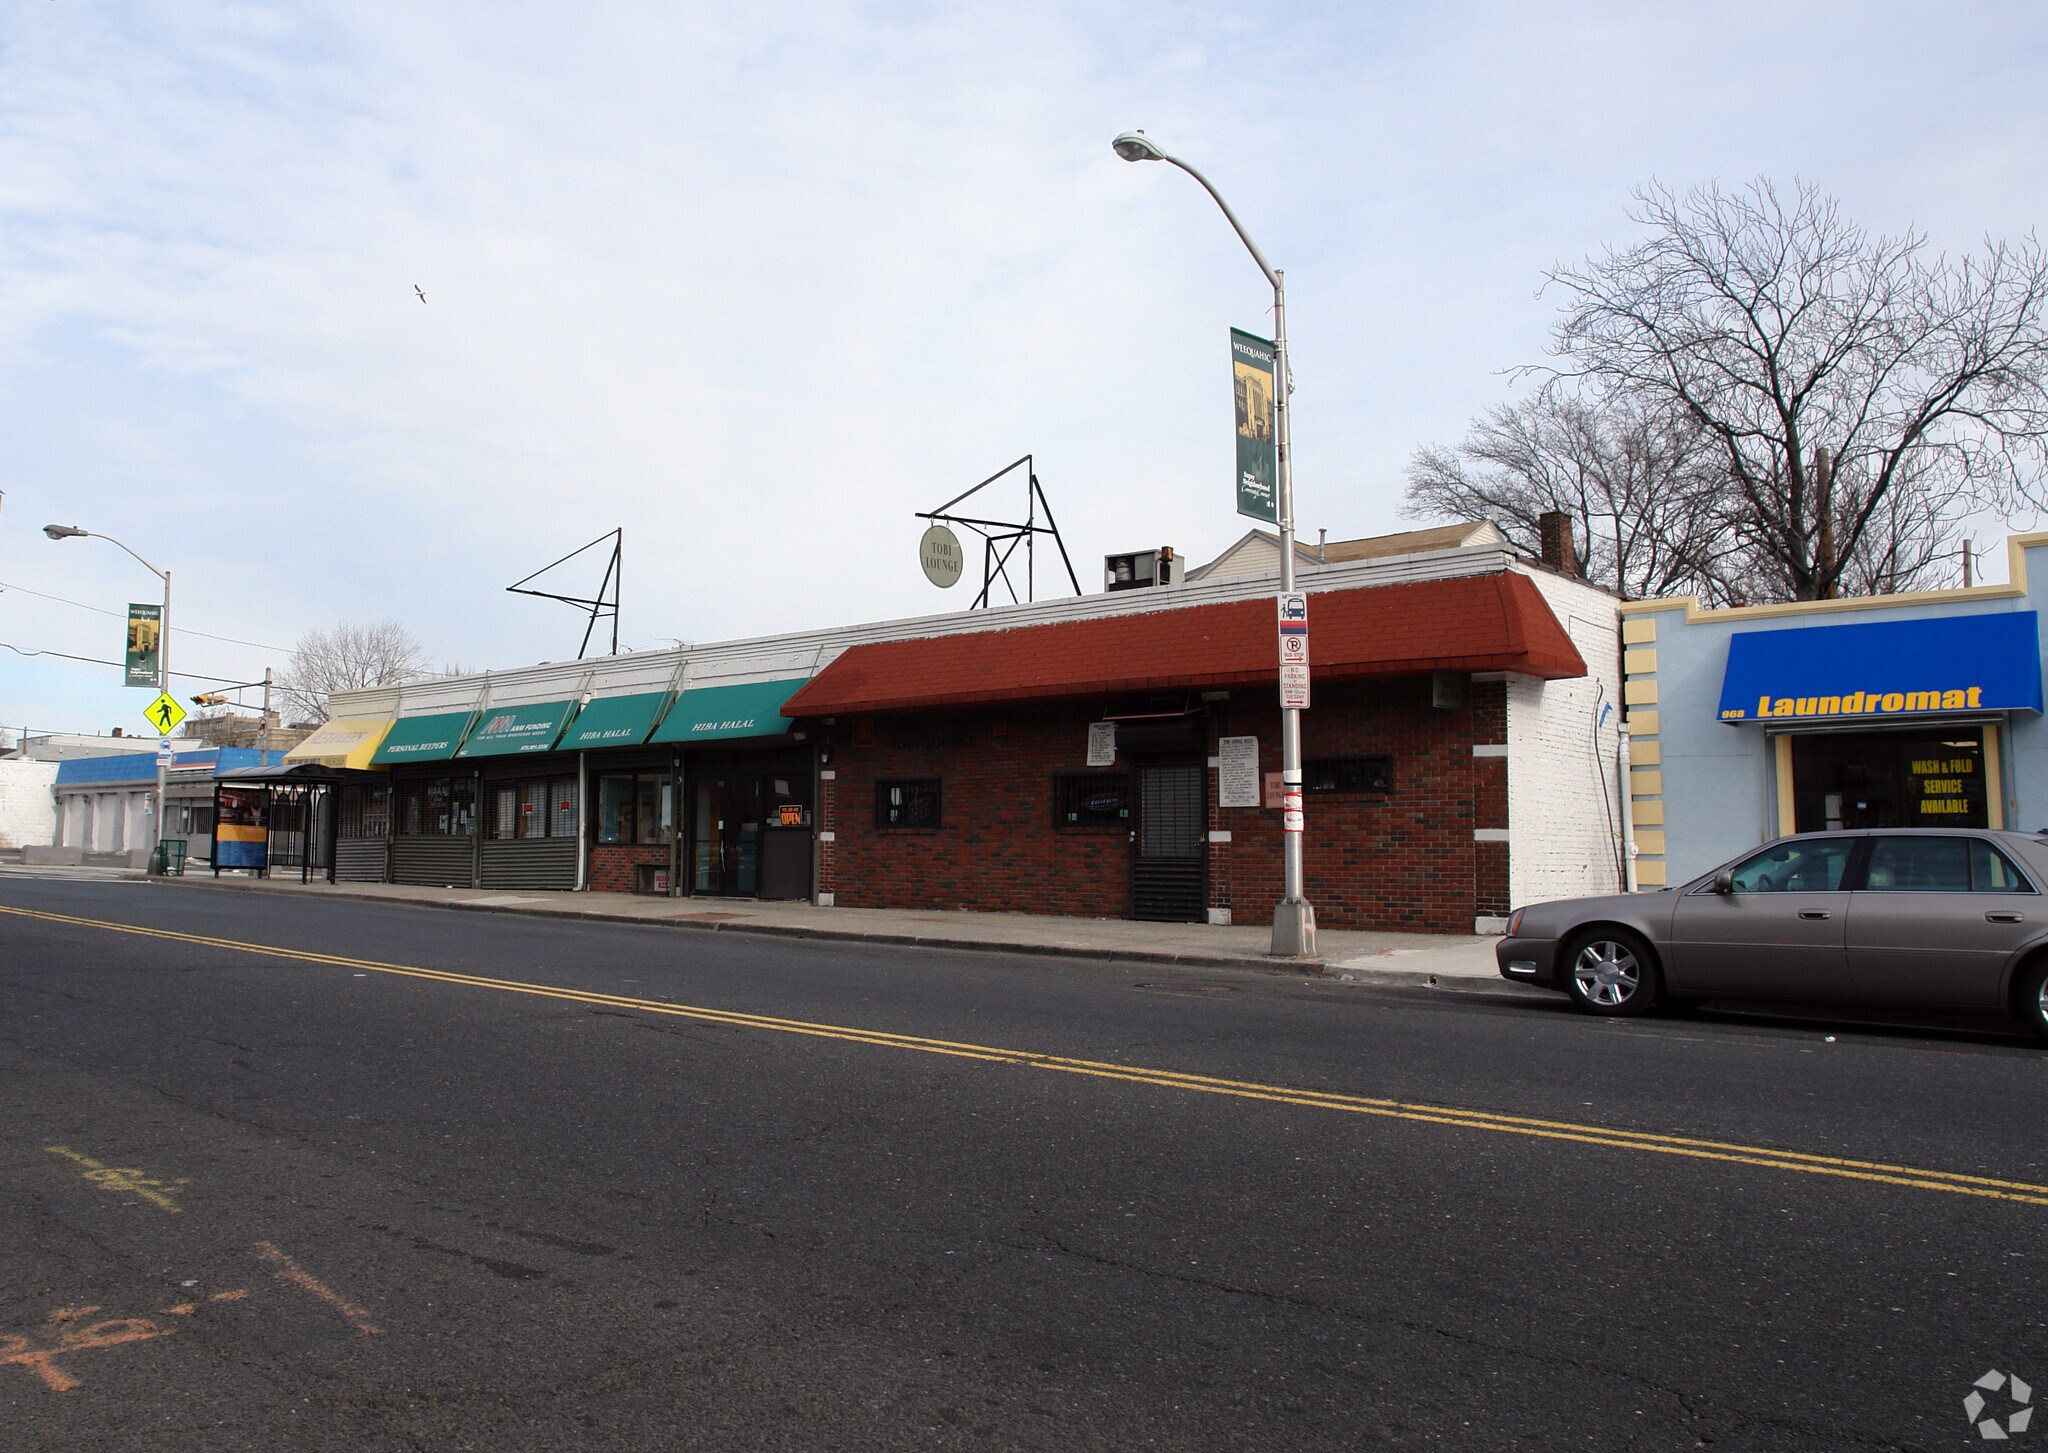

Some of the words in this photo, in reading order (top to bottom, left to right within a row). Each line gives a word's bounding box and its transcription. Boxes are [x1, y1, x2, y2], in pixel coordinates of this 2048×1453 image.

[1233, 341, 1271, 363] WEEQUAHIC
[931, 542, 952, 556] TOBI
[925, 556, 959, 573] LOUNGE
[1757, 686, 1982, 717] Laundromat
[1721, 709, 1745, 719] 968
[524, 722, 553, 731] FUNDING
[691, 721, 718, 732] HIBA
[720, 719, 755, 730] HALAL
[579, 730, 601, 740] HIBA
[602, 728, 632, 739] HALAL
[387, 743, 420, 753] PERSONAL
[418, 741, 449, 751] BEEPERS
[1911, 760, 1940, 774] WASH
[1941, 761, 1949, 773] &
[1950, 759, 1973, 773] FOLD
[1924, 779, 1963, 794] SERVICE
[1921, 799, 1969, 814] AVAILABLE
[781, 812, 801, 825] OPEN
